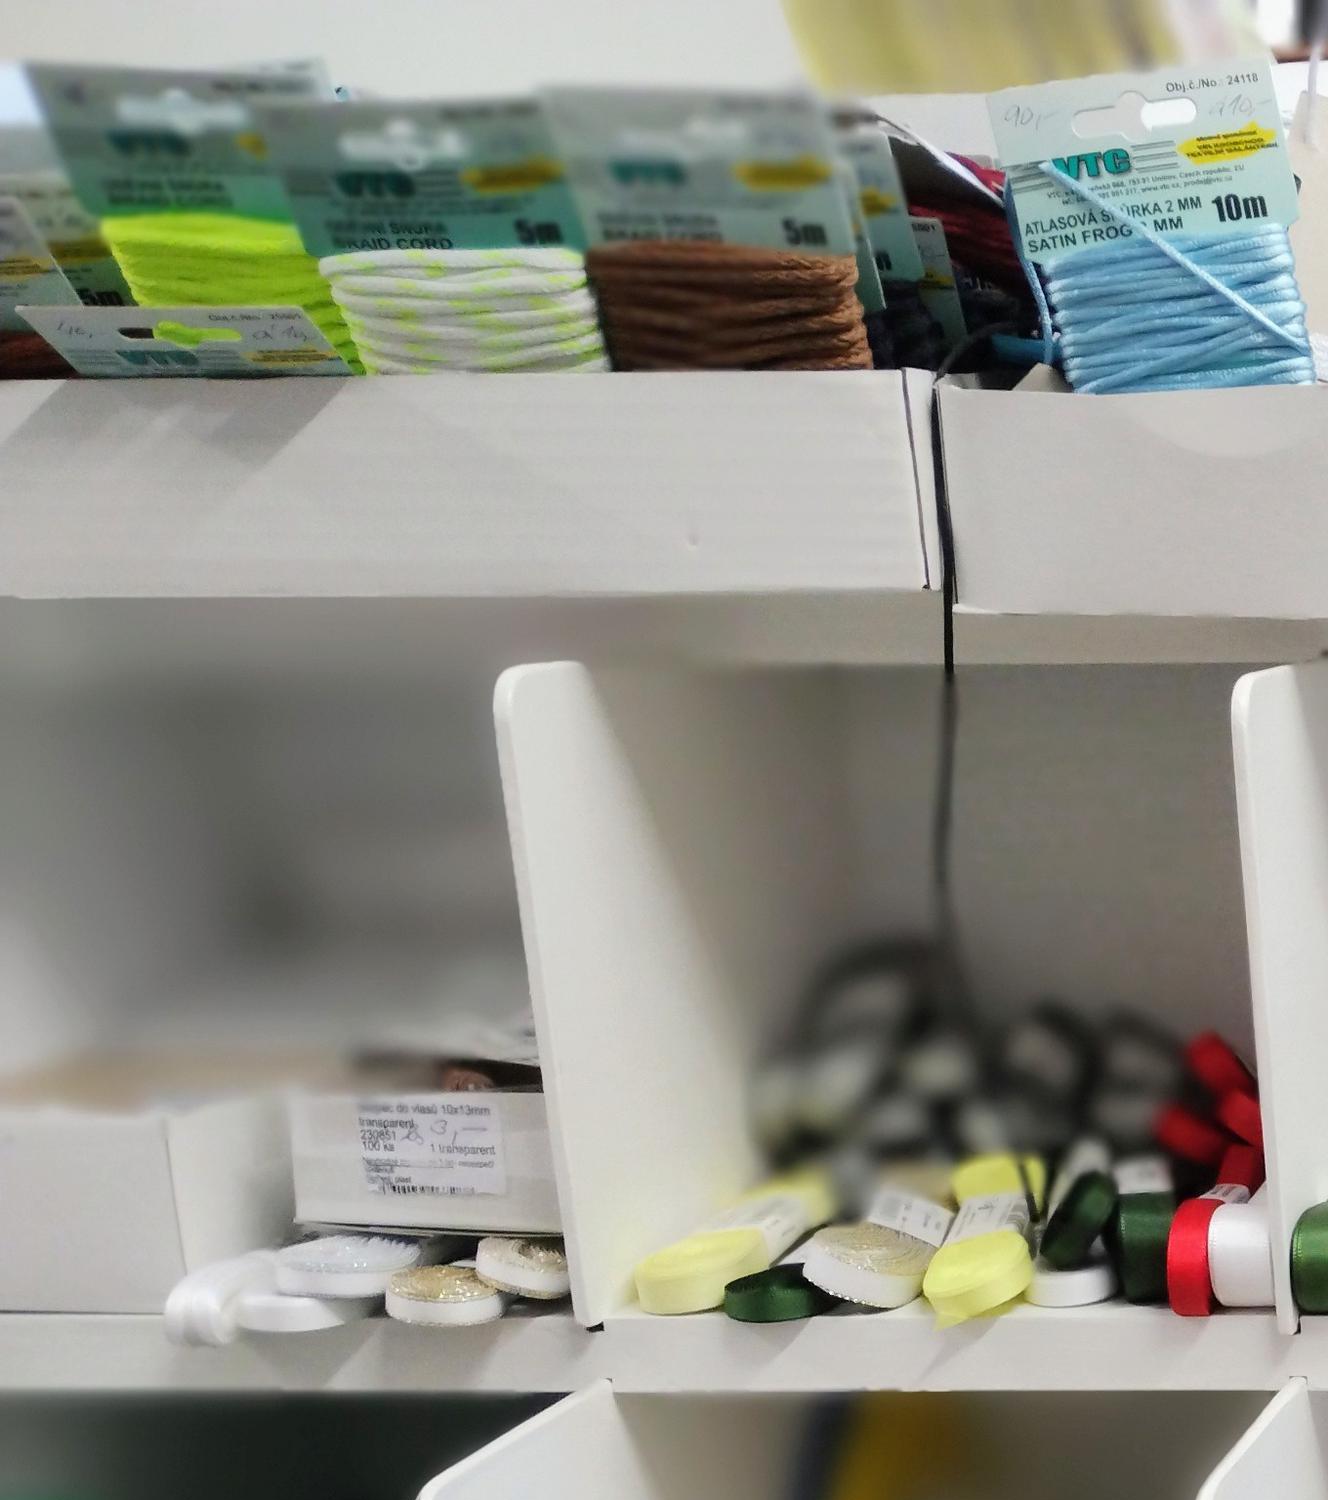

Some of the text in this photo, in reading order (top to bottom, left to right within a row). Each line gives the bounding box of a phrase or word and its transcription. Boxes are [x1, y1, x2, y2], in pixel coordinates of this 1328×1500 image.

[1226, 72, 1259, 86] 24118
[1050, 148, 1132, 180] VTC
[1025, 208, 1097, 237] ATLASOVÁ
[1167, 200, 1176, 213] 2
[1177, 195, 1202, 211] MM
[1211, 193, 1269, 223] 10m
[1028, 234, 1078, 253] SATIN
[1082, 223, 1134, 244] FROG
[1153, 216, 1184, 233] MM
